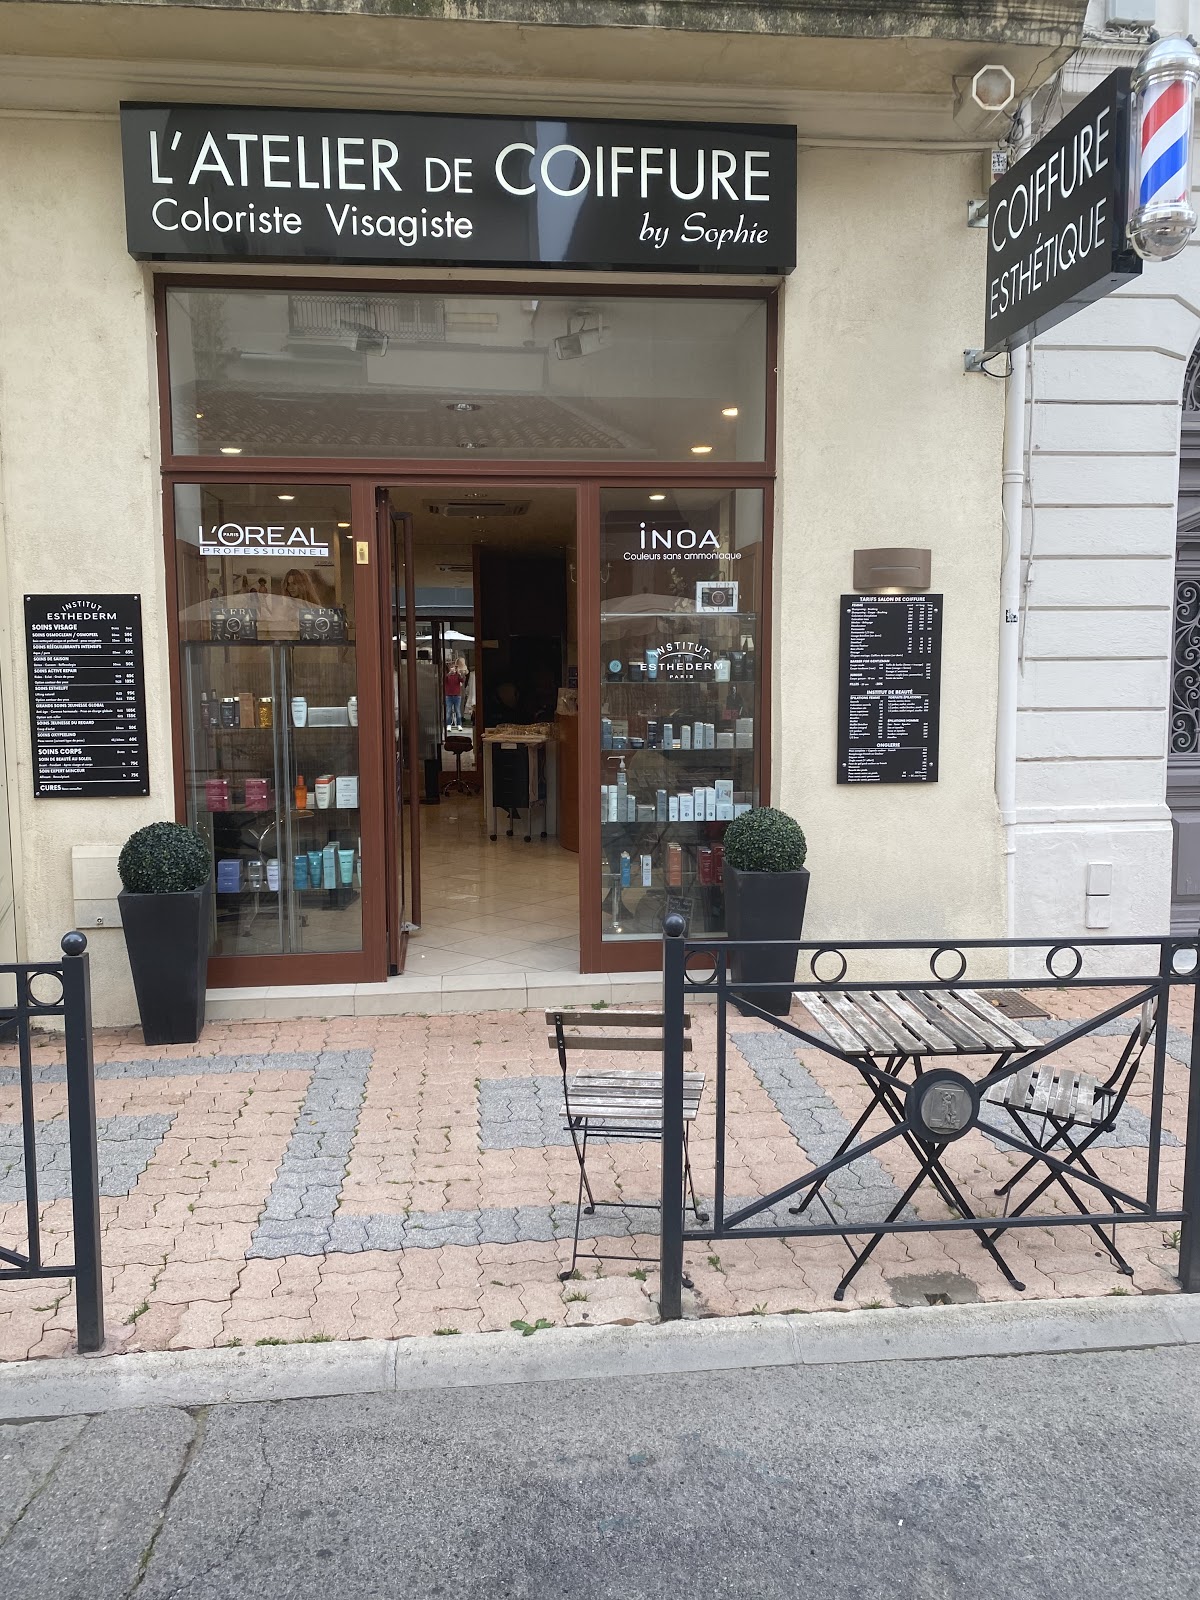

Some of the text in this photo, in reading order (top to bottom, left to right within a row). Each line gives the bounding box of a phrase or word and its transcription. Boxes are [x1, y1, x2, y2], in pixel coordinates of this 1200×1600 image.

[149, 129, 770, 201] L'ATELIER DE COIFFURE
[992, 106, 1110, 252] COIFFURE
[152, 198, 473, 245] Coloriste Visagiste
[639, 212, 769, 249] by Sophie
[990, 197, 1106, 320] ESTHÉTIQUE
[202, 547, 326, 555] PROFESSIONNEL
[624, 552, 661, 560] Couleurs
[684, 552, 741, 560] ammoniaque
[62, 601, 102, 611] INSTITUT
[654, 642, 710, 657] INSTITUT
